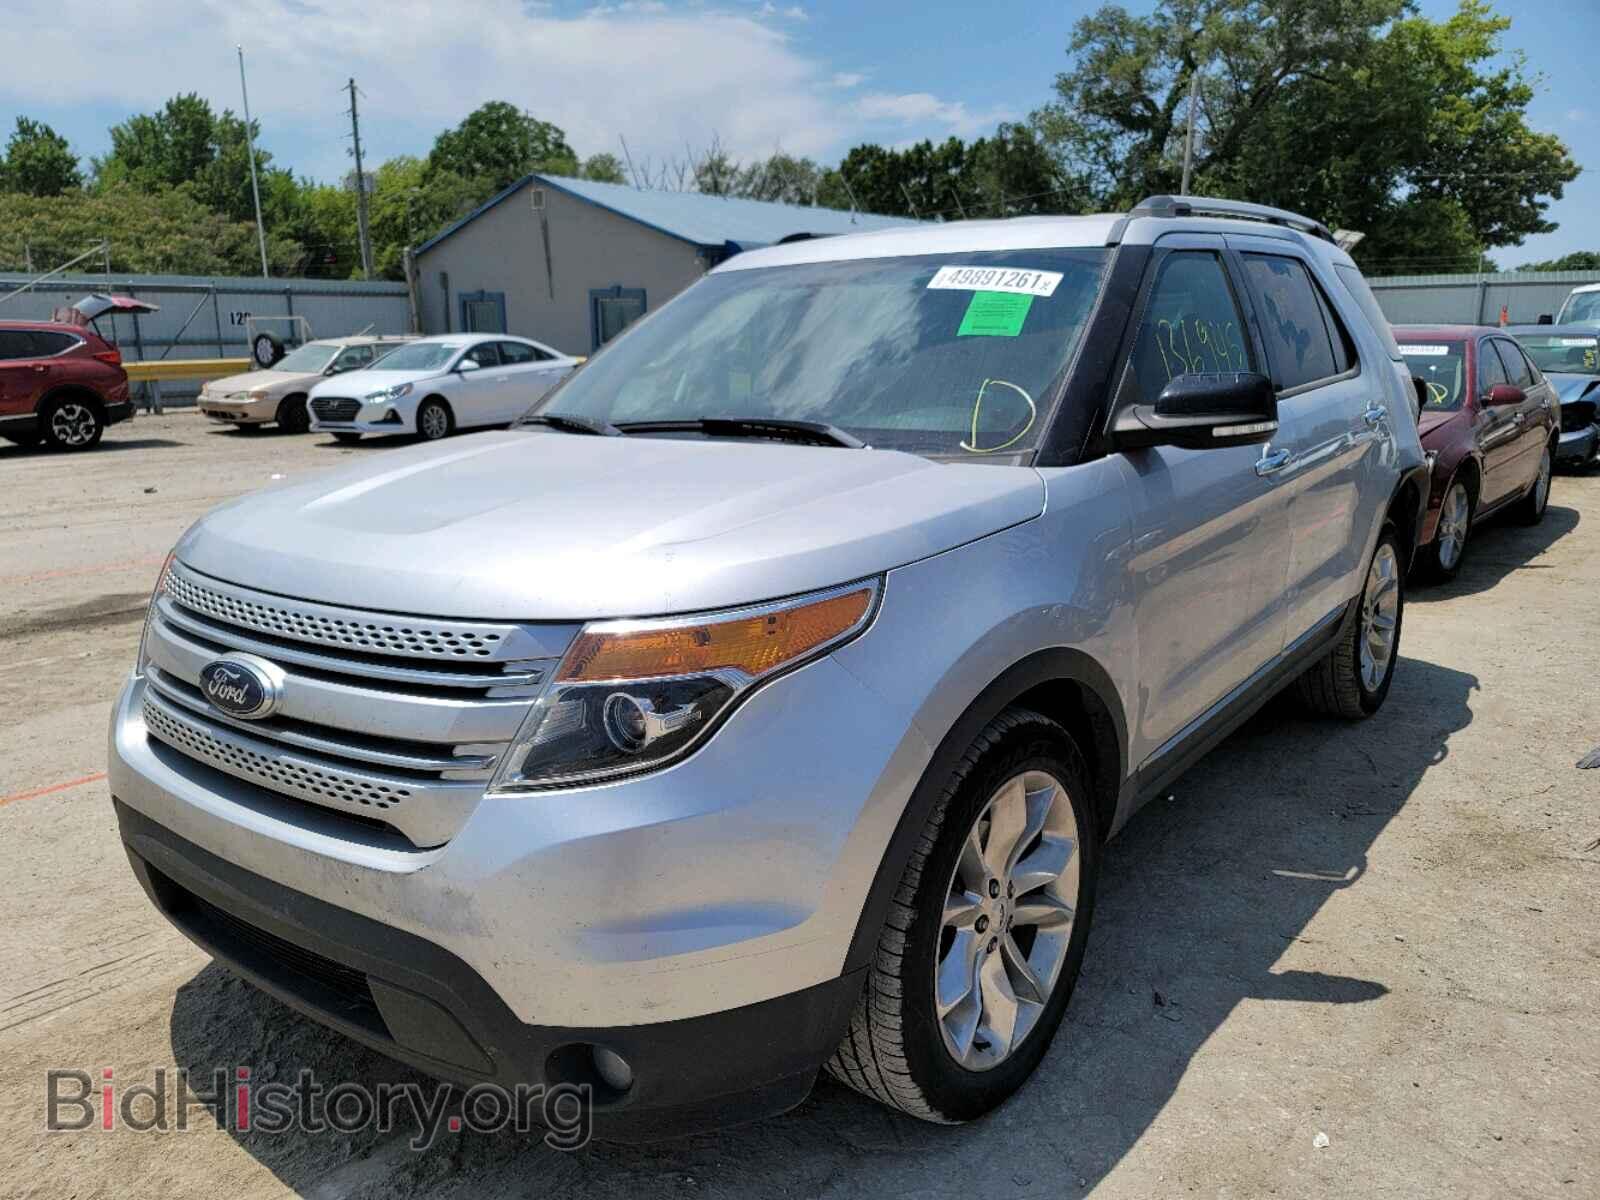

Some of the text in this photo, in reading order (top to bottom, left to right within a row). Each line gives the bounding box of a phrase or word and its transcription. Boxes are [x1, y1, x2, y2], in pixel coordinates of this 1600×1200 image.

[947, 268, 1043, 290] 49891261
[959, 378, 1037, 453] D
[208, 667, 249, 705] Ford
